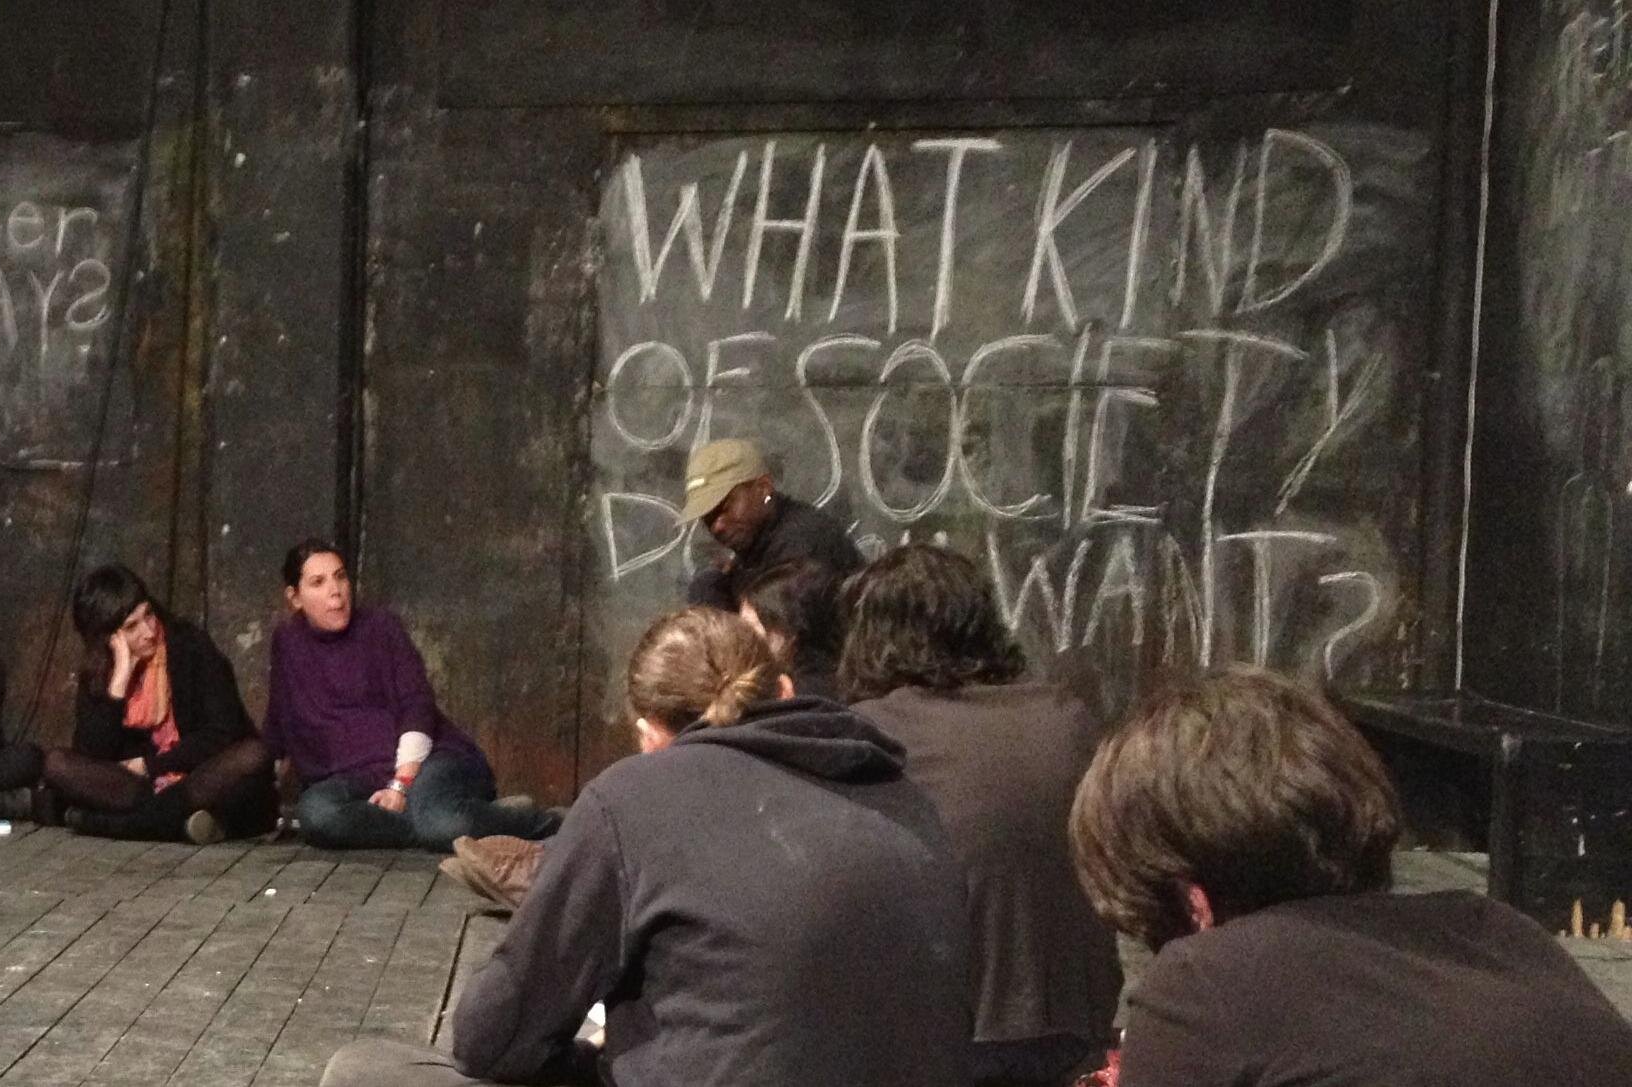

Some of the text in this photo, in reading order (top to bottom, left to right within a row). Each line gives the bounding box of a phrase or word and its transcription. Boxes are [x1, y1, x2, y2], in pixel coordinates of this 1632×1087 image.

[622, 128, 1352, 344] WHAT KIND
[606, 325, 1384, 532] OF SOCIETY
